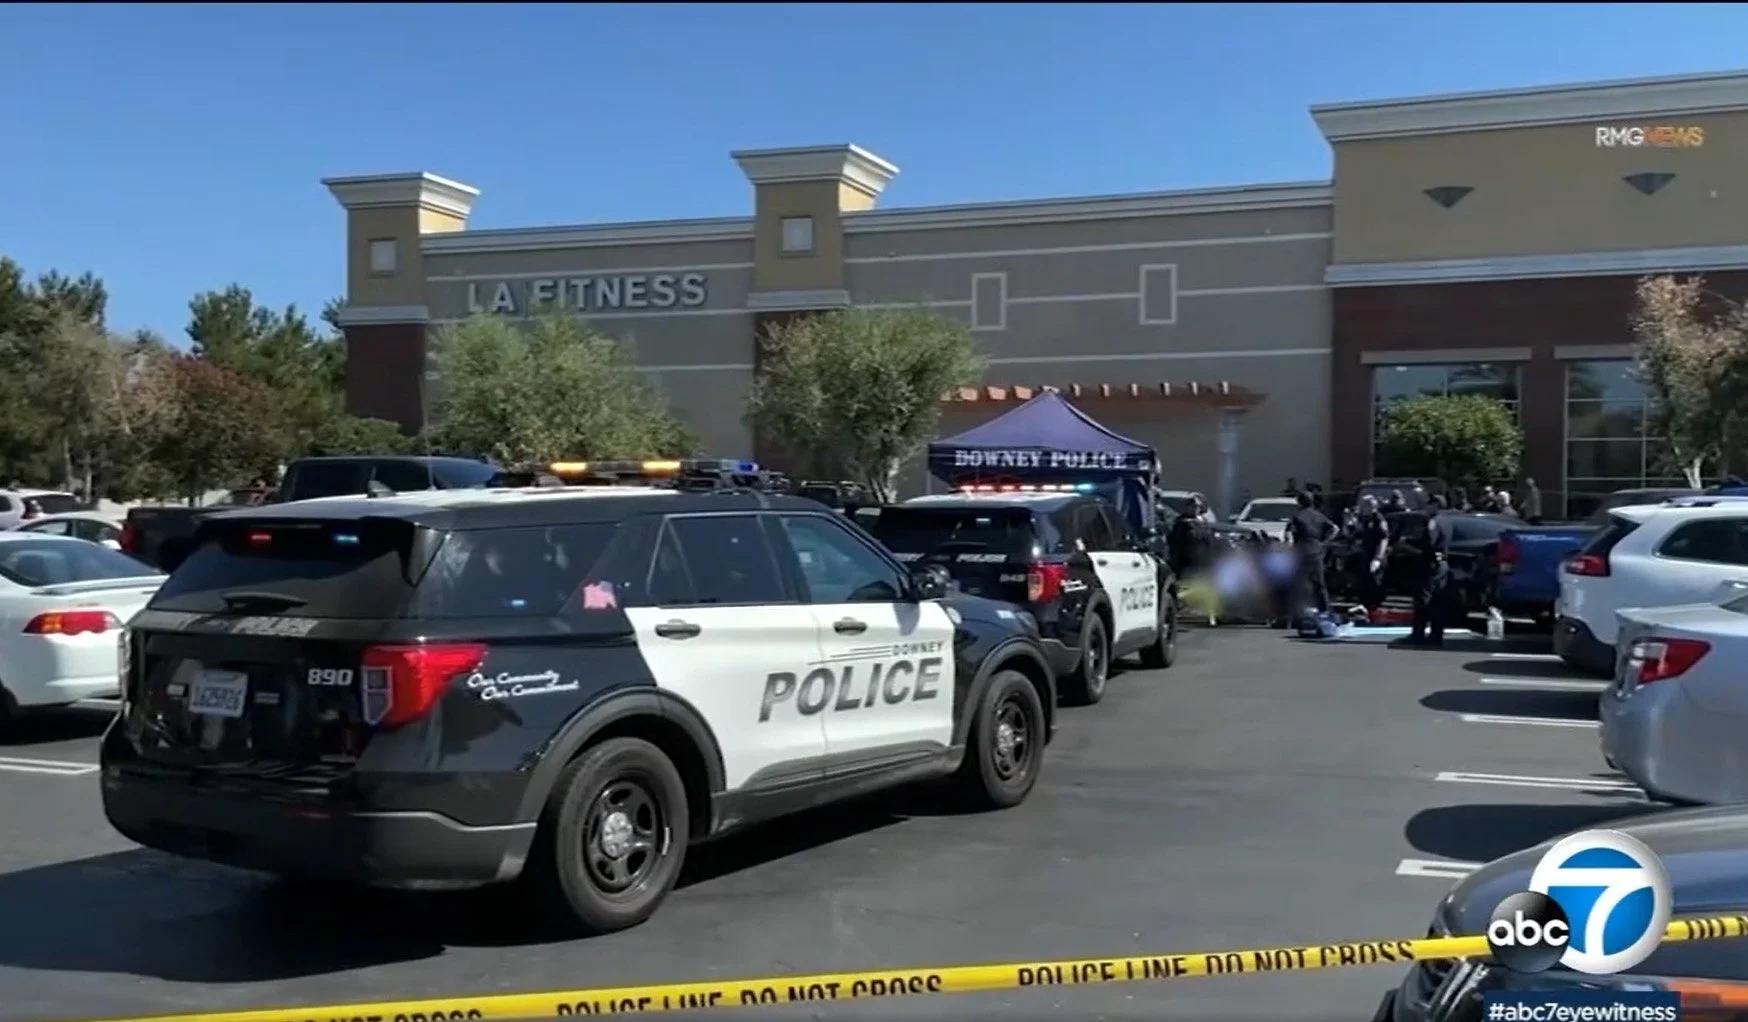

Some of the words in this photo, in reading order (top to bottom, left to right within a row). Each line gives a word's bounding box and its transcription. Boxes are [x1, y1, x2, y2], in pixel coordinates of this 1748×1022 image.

[467, 282, 516, 312] LA
[532, 273, 706, 309] FITNESS
[954, 450, 1041, 467] DOWNEY
[1049, 452, 1127, 470] POLICE
[892, 641, 944, 655] DOWNEY
[307, 668, 354, 685] 890
[758, 657, 943, 723] POLICE
[1254, 949, 1306, 970] NOT
[1319, 941, 1413, 966] CROSS
